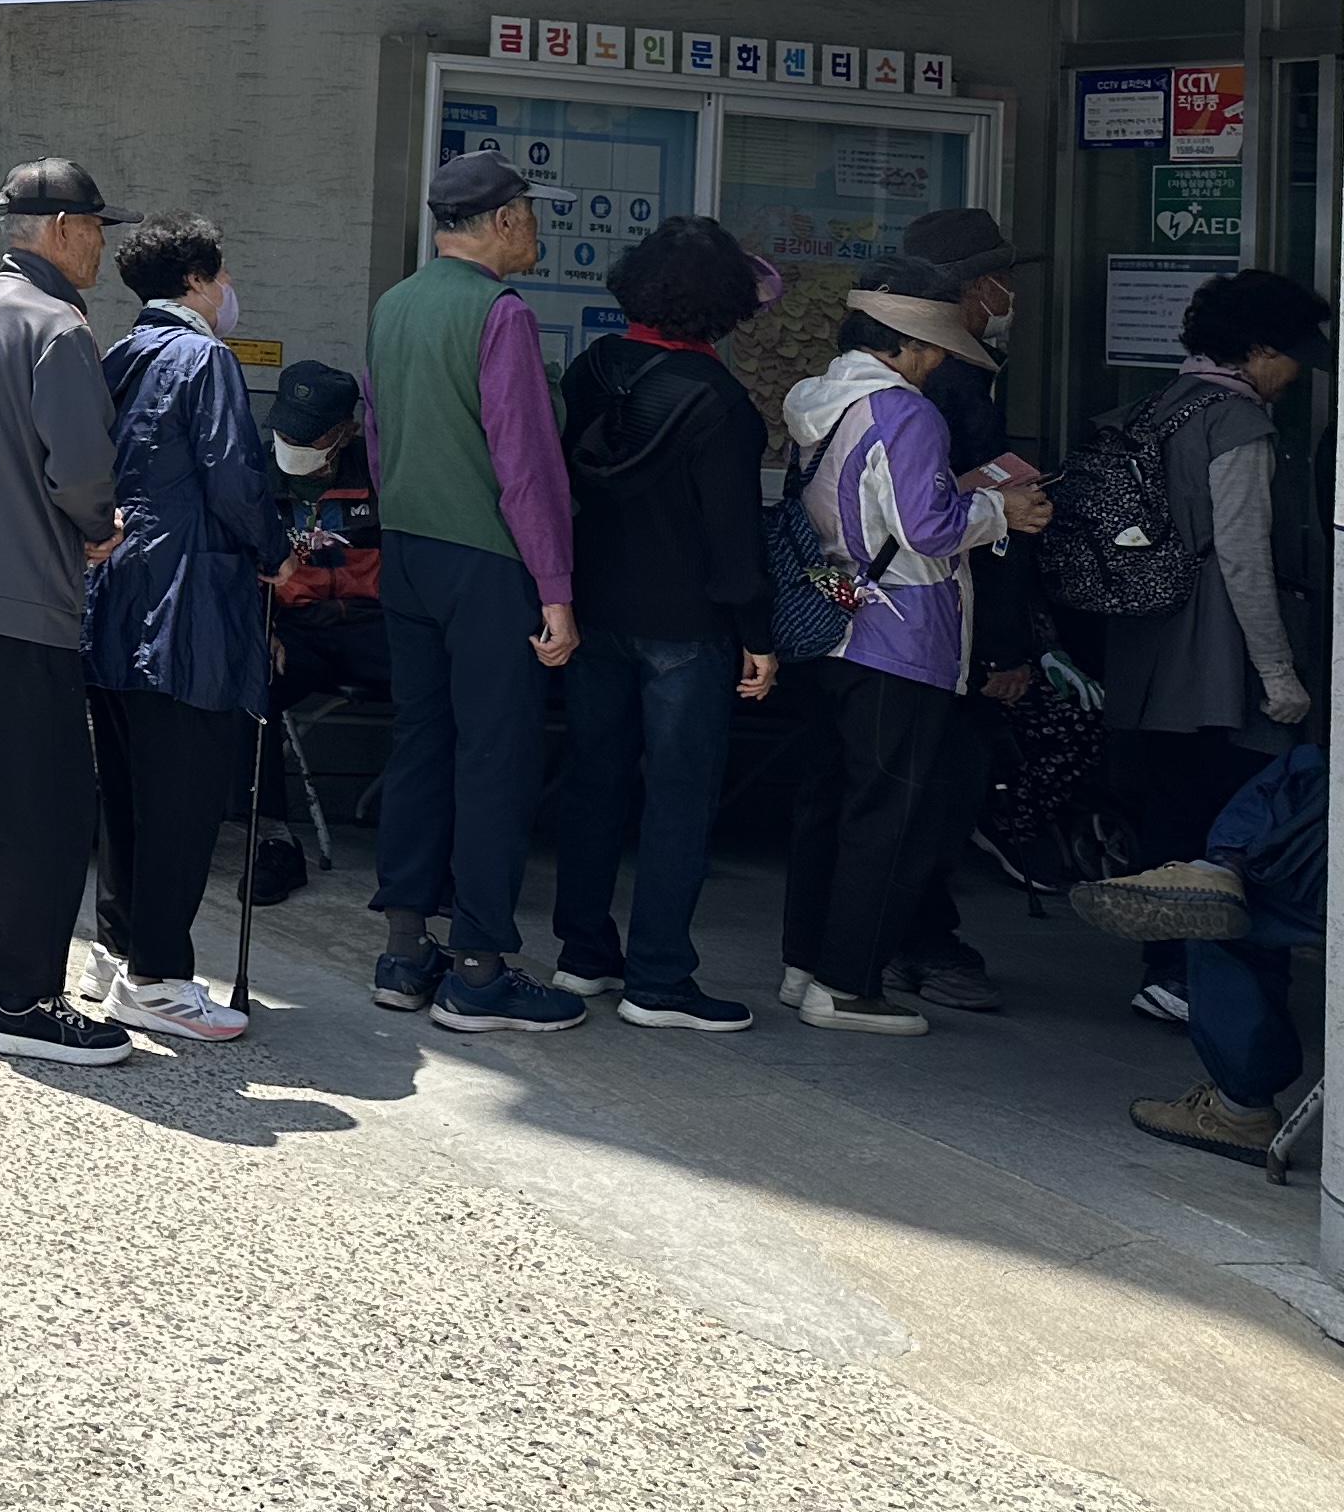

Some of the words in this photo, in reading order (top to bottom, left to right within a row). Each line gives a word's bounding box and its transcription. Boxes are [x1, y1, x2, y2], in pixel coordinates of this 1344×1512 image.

[1097, 80, 1119, 90] CCTV
[1178, 72, 1220, 93] CCTV
[1192, 217, 1241, 235] AED
[772, 237, 832, 256] 금강이네
